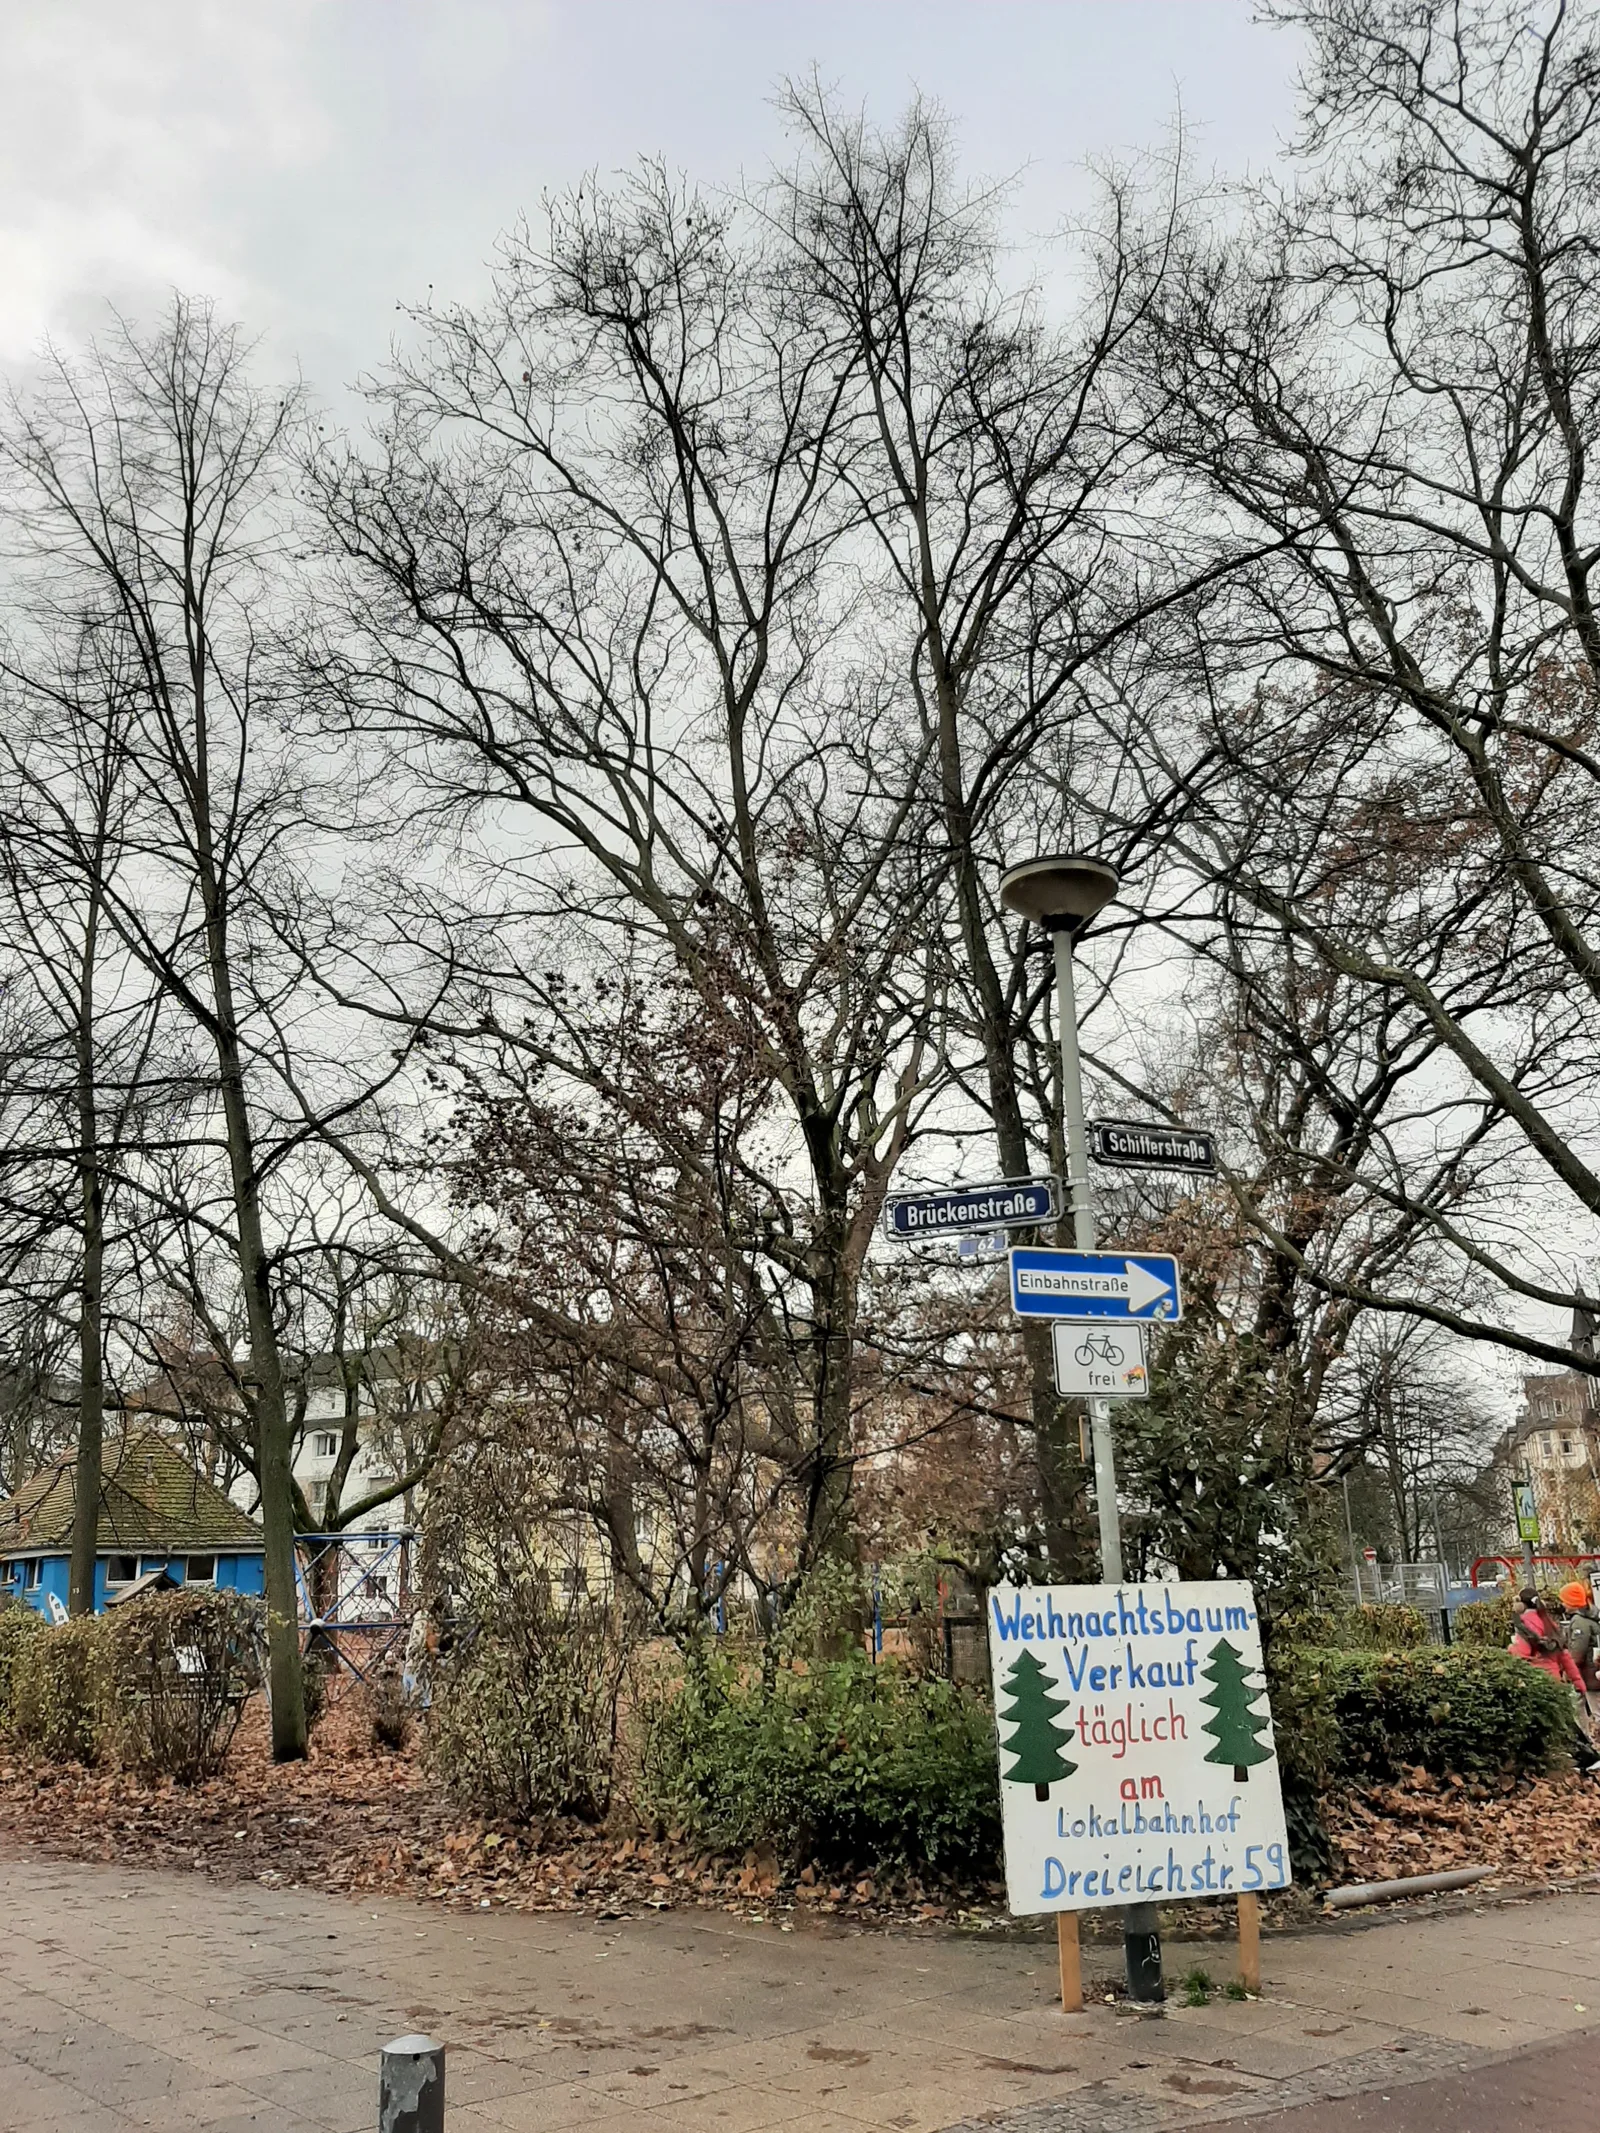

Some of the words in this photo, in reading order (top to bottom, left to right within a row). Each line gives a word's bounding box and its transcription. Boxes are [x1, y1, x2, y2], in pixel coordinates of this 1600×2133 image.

[1109, 1132, 1206, 1161] Schifferstraße
[907, 1193, 1037, 1227] Brückenstraße
[978, 1237, 995, 1250] 62
[1020, 1273, 1129, 1292] Einbahnstraße
[1088, 1371, 1116, 1386] frei
[992, 1588, 1257, 1641] Weihnachtsbaum-
[1063, 1639, 1199, 1692] Verkauf
[1075, 1697, 1188, 1758] täglich
[1120, 1776, 1165, 1801] am
[1057, 1796, 1241, 1839] Lokalbahnhof
[1040, 1846, 1234, 1898] Dreieichstr.
[1242, 1843, 1285, 1889] 59
